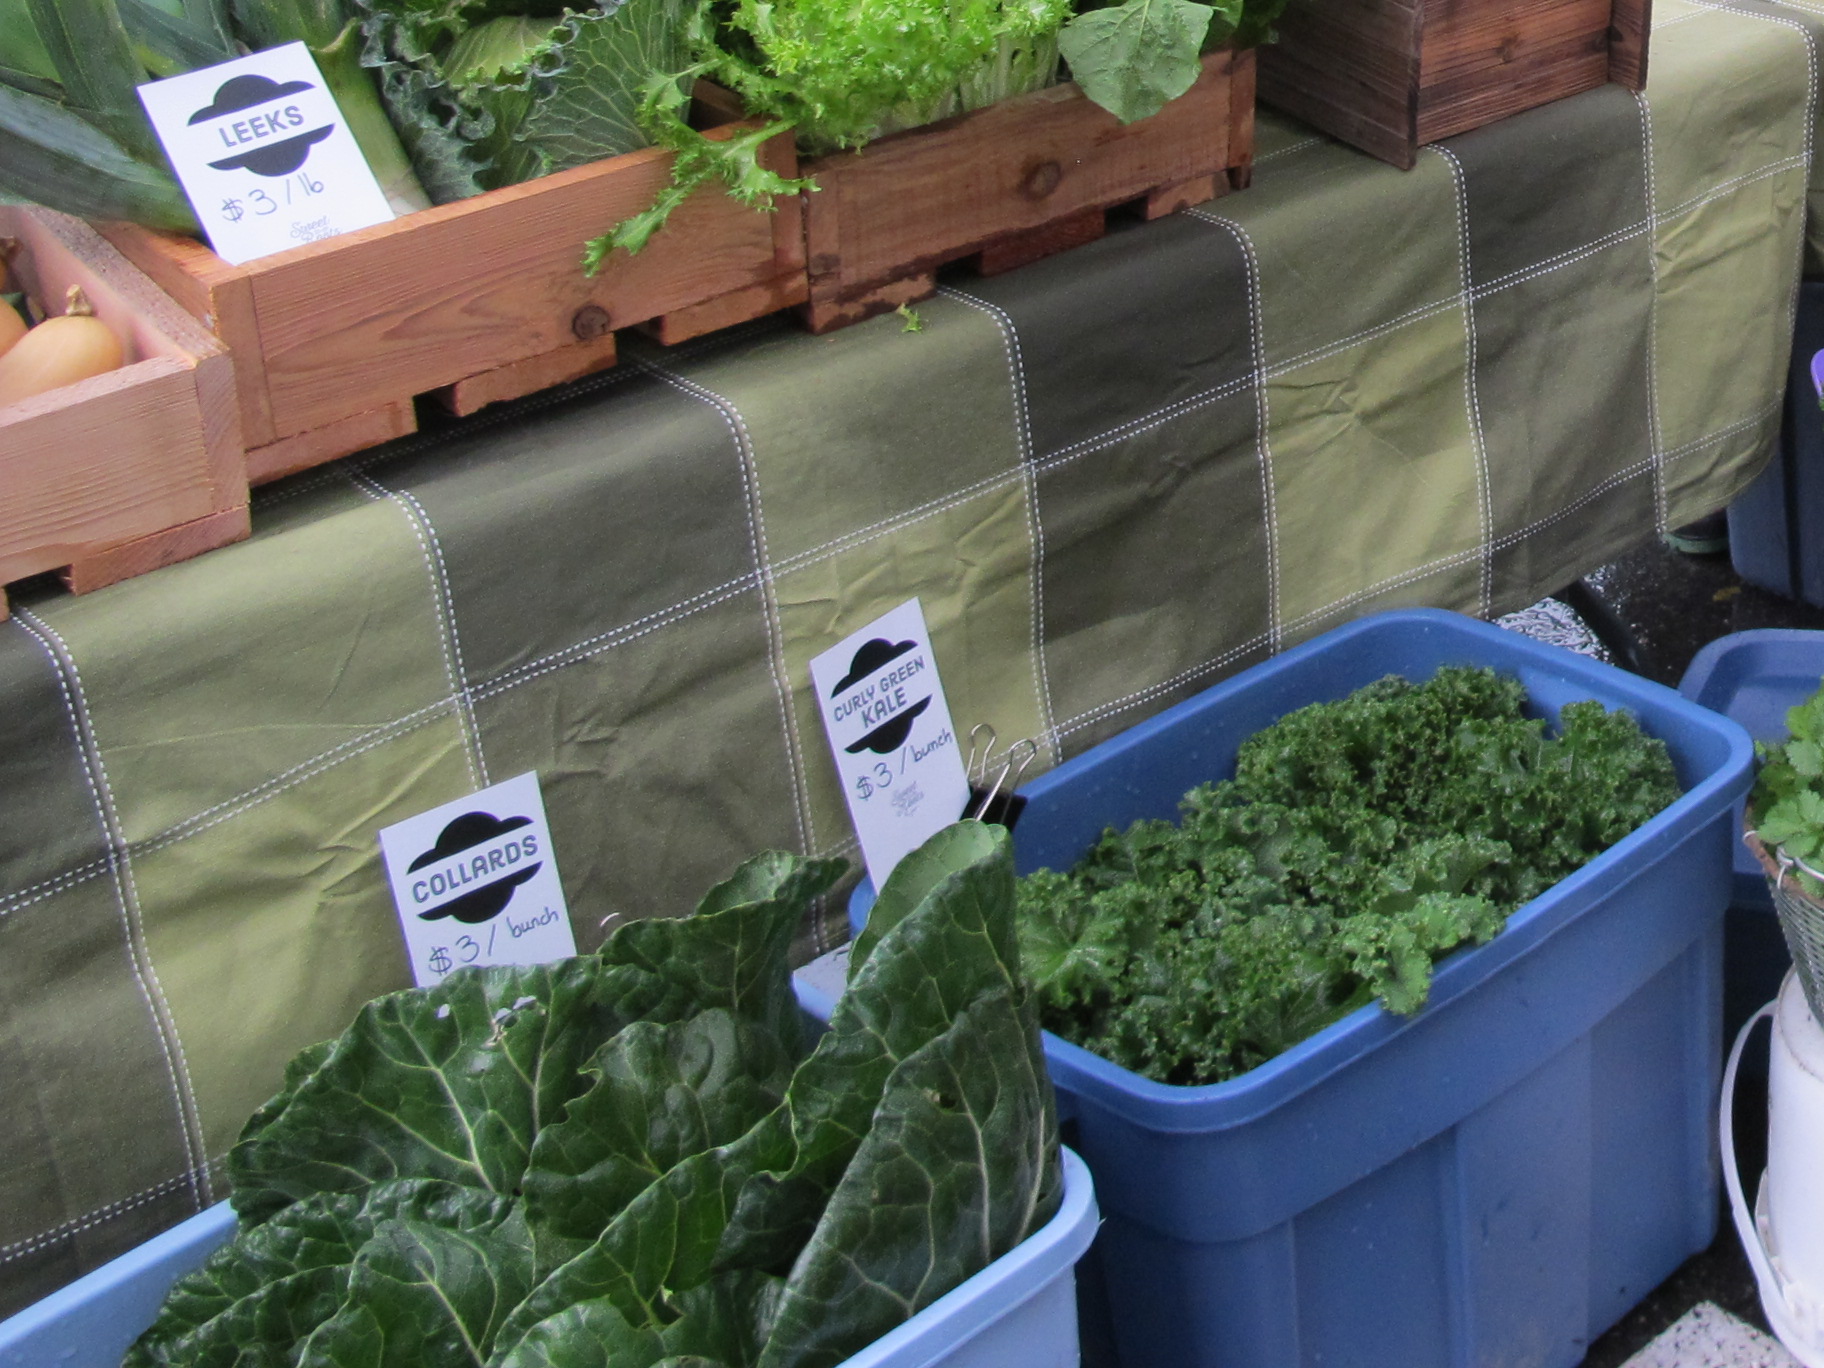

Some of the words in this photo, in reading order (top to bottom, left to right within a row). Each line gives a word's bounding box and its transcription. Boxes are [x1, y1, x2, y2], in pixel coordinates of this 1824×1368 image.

[218, 105, 305, 148] LEEKS
[833, 683, 875, 723] CURLY
[879, 655, 926, 692] GREEN
[860, 686, 908, 729] KALE
[412, 834, 539, 904] COLLARDS
